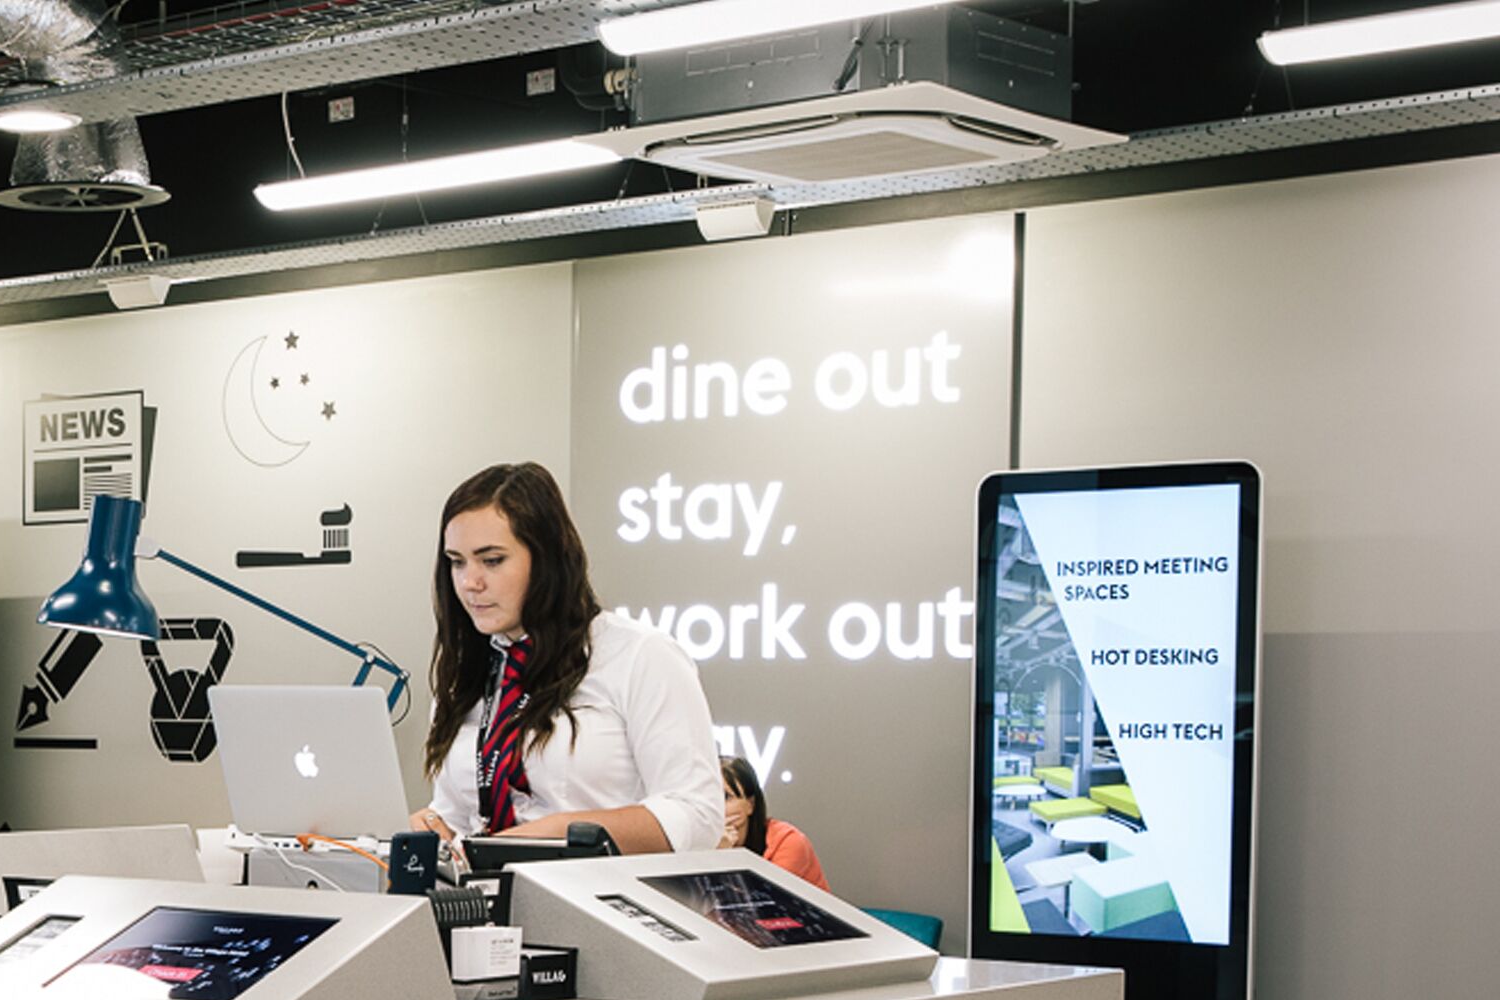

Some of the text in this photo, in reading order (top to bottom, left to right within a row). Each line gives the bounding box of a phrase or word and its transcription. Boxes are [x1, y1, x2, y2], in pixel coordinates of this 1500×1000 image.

[619, 329, 963, 423] dine out
[39, 407, 126, 442] NEWS
[617, 472, 797, 556] stay,
[1056, 556, 1230, 577] INSPIRED MEETING
[1064, 583, 1130, 601] SPACES
[1090, 648, 1220, 666] HOT DESKING
[1118, 723, 1224, 741] HIGH TECH
